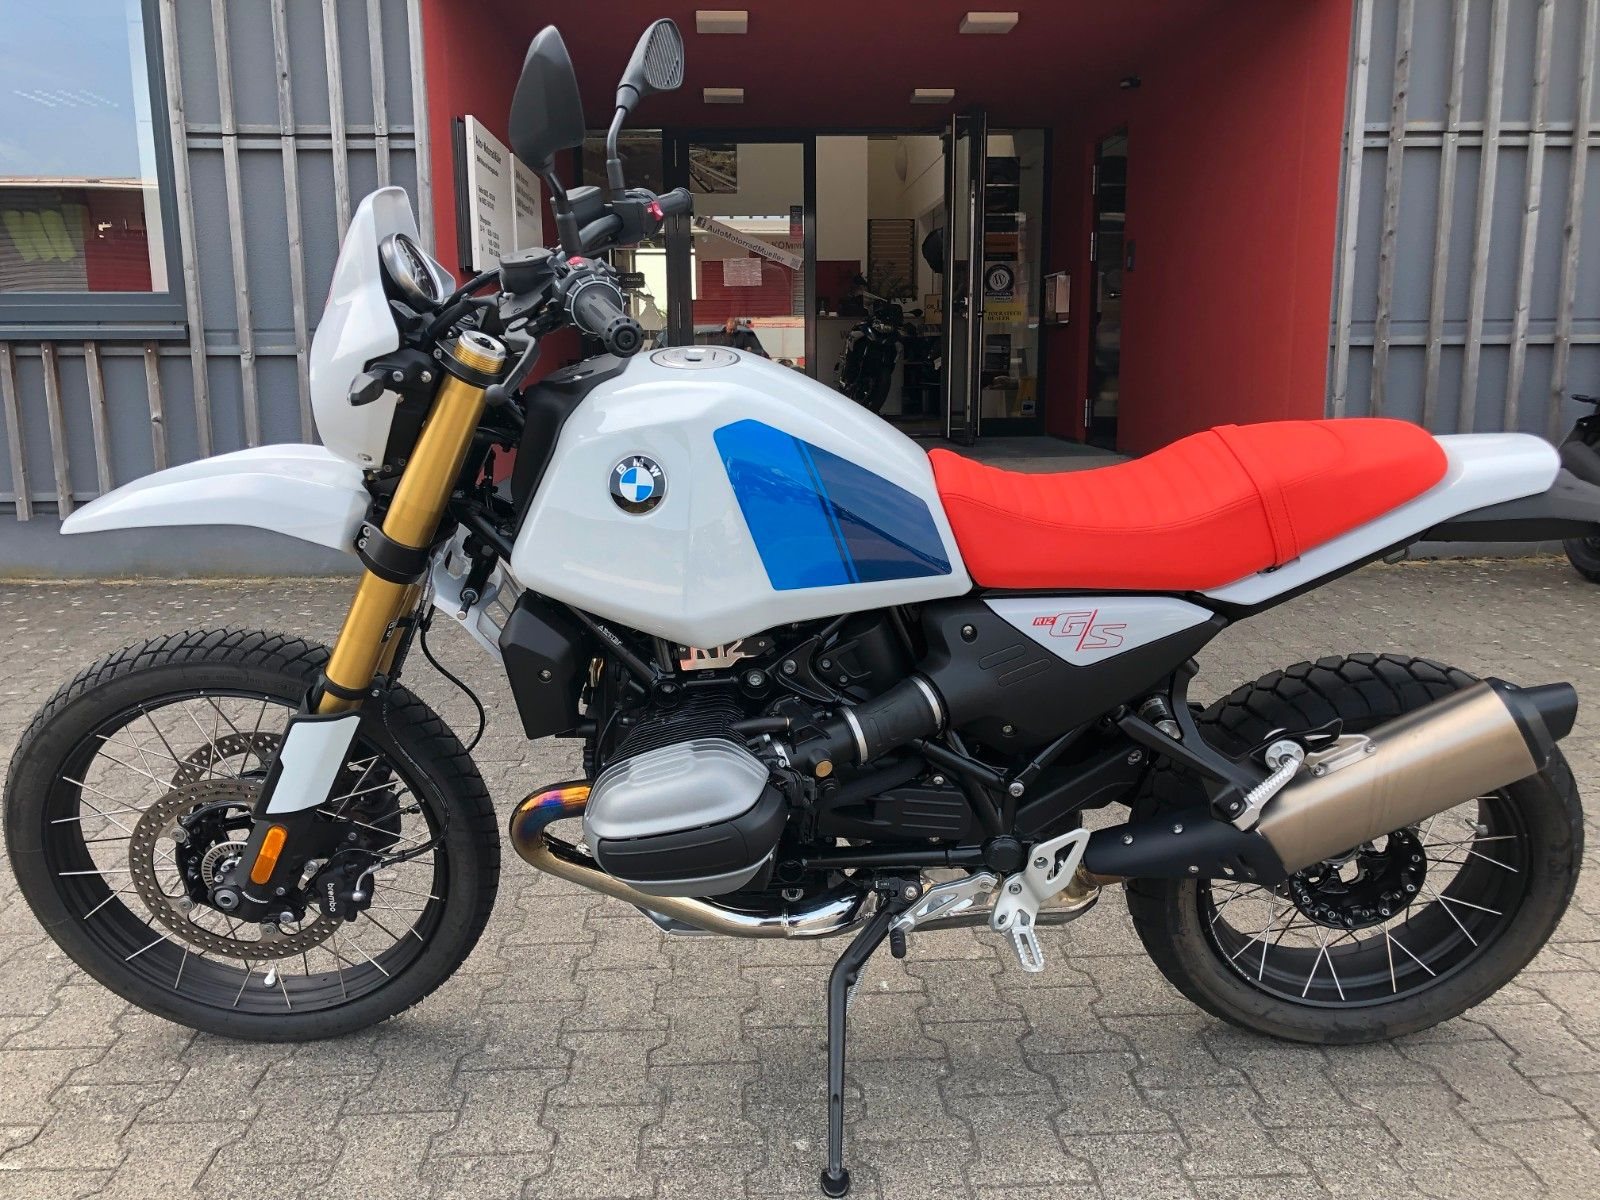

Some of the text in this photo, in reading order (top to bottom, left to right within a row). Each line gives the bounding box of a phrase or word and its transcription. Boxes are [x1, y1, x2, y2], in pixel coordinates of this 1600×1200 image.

[706, 224, 785, 262] AutoMotorradMueller
[615, 458, 662, 478] BMW
[327, 882, 338, 912] brembo
